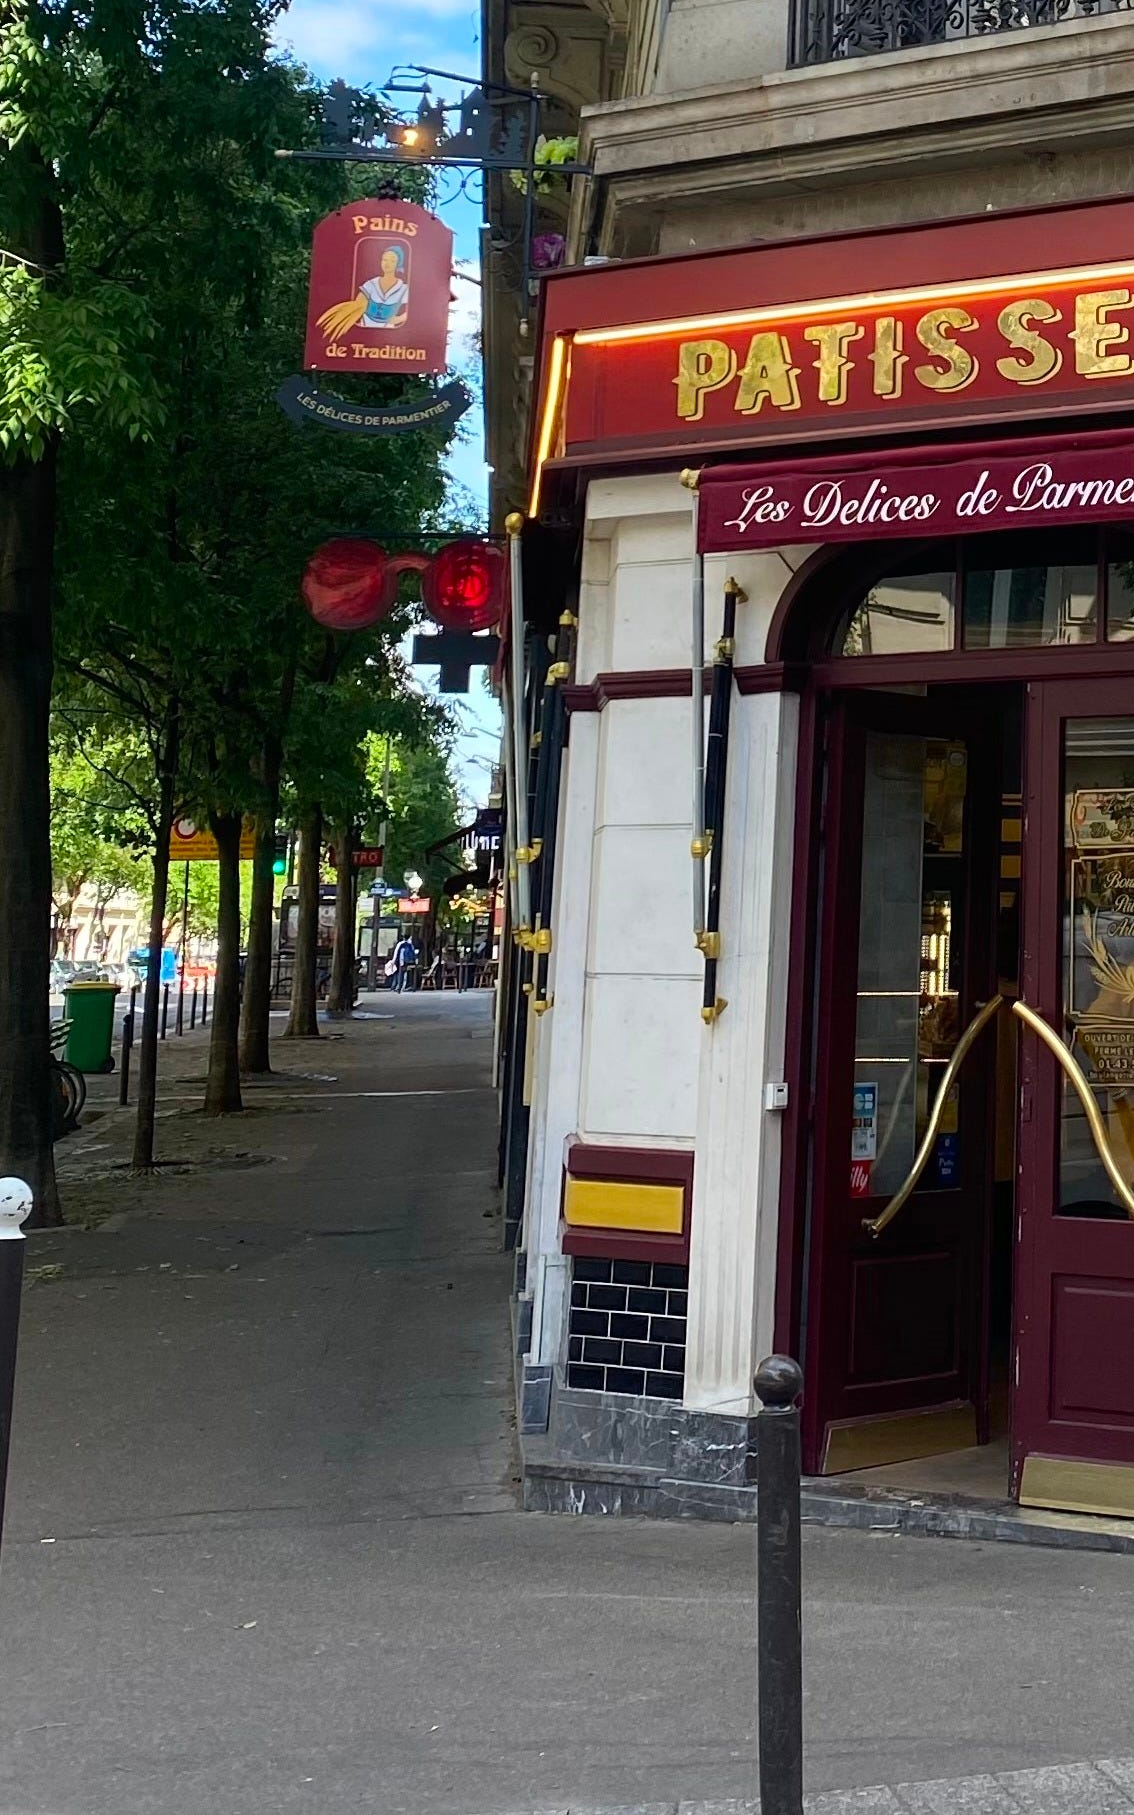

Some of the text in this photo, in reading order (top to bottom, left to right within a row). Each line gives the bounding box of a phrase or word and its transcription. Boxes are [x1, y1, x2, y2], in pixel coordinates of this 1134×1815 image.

[352, 214, 420, 236] Pains
[325, 342, 427, 361] de Tradition
[296, 391, 453, 426] LES DÉLICES DE PARMENTIER
[723, 485, 795, 533] Les
[800, 472, 940, 530] Delices
[956, 470, 1000, 518] de
[1084, 1034, 1117, 1043] OUVERT
[850, 1165, 869, 1192] illy
